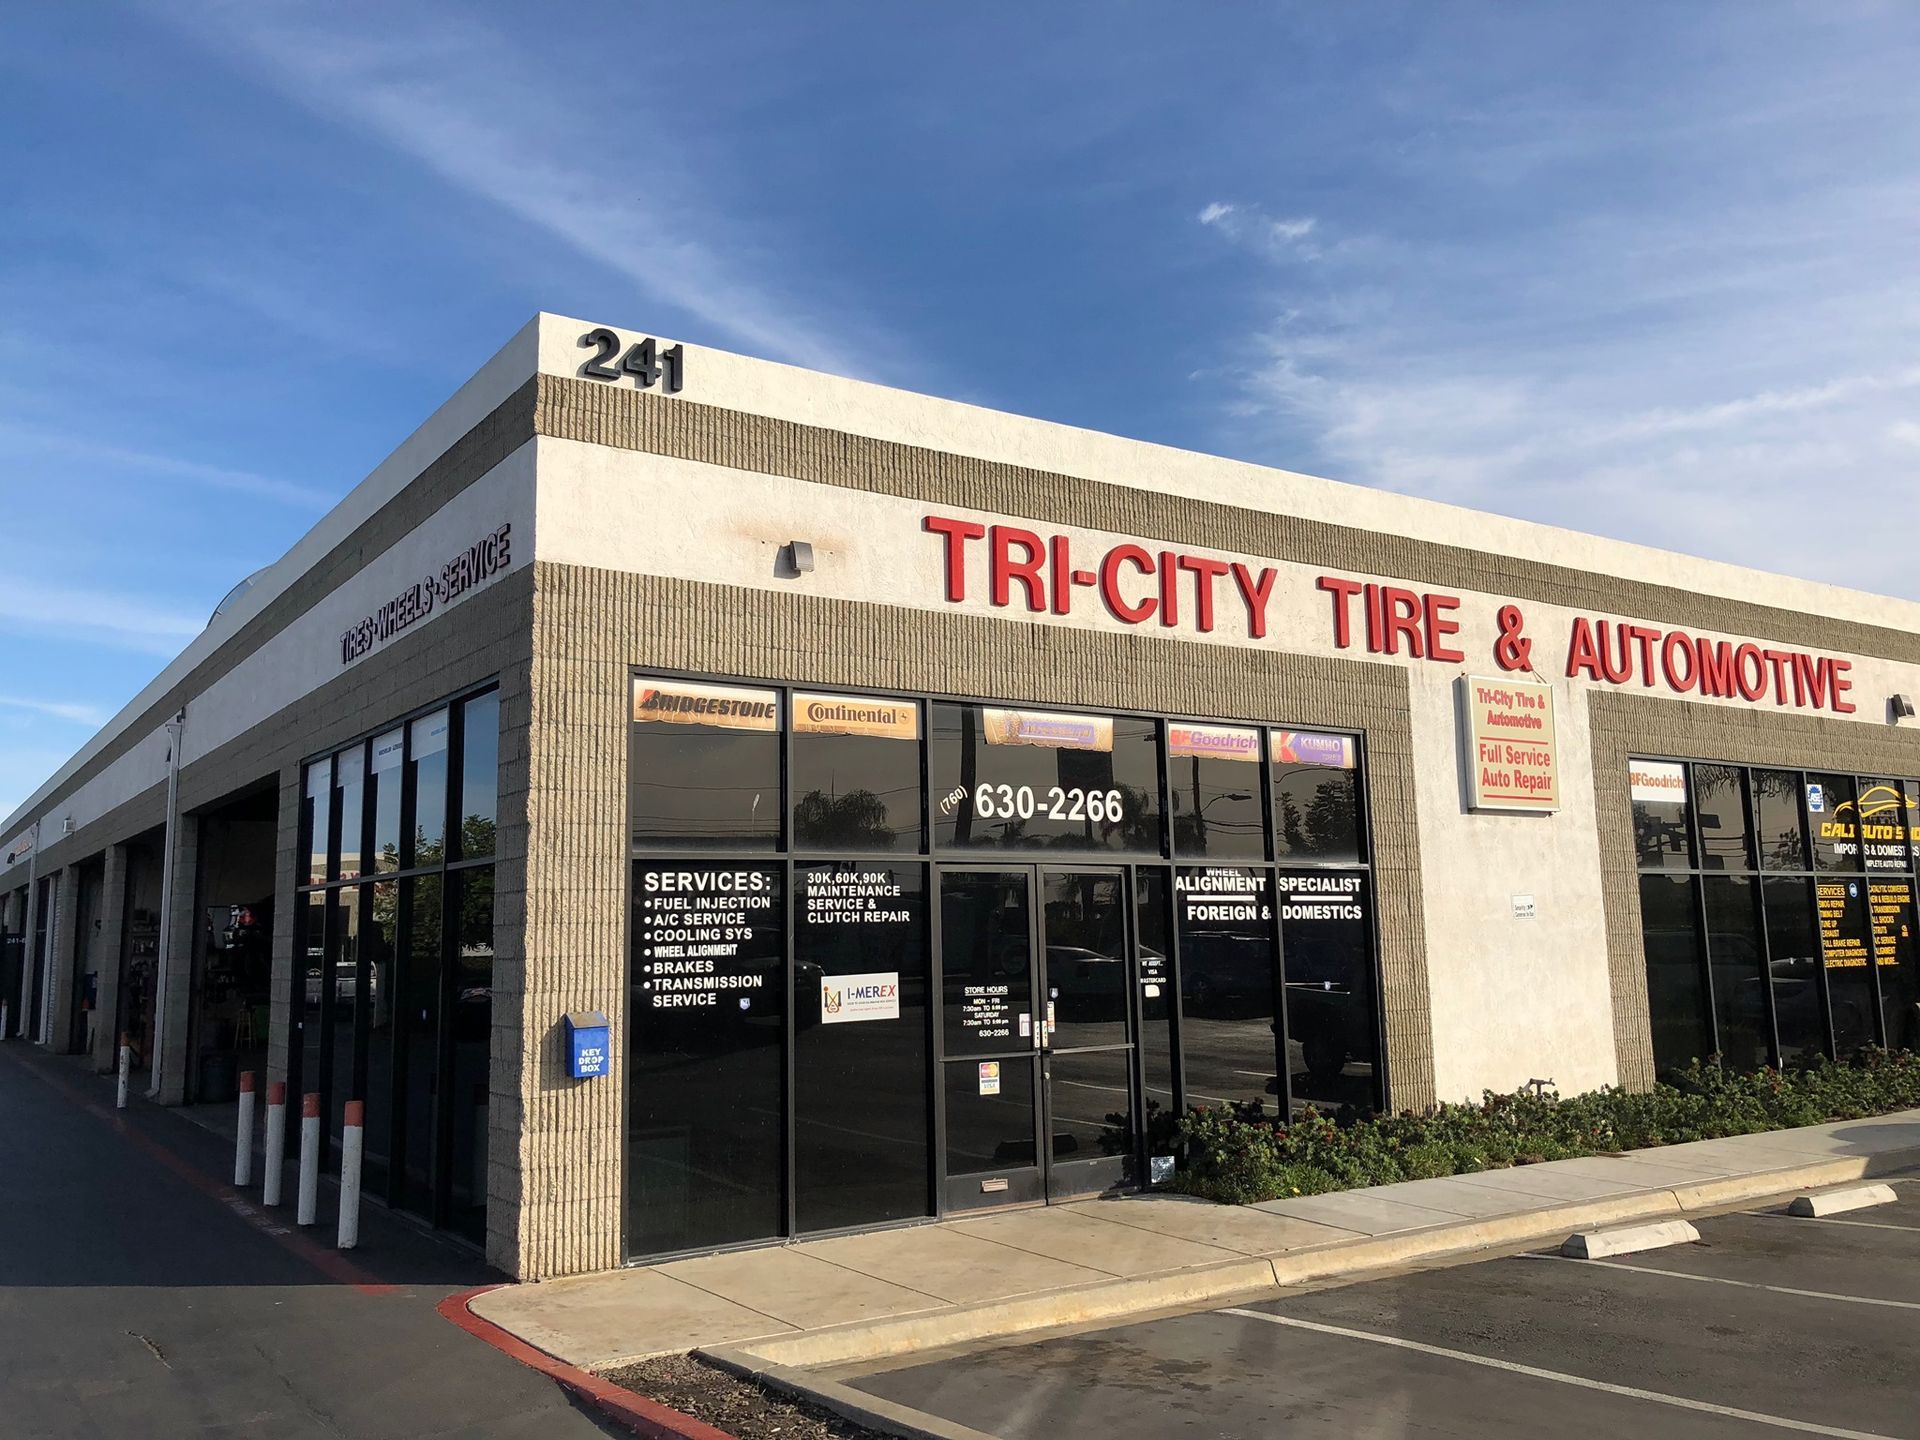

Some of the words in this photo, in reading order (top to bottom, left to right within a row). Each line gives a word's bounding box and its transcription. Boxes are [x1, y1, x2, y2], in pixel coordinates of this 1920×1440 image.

[579, 328, 684, 392] 241
[922, 516, 1278, 638] TRI-CITY
[1315, 576, 1465, 663] TIRE
[1495, 604, 1533, 671] &
[1565, 616, 1857, 713] AUTOMOTIVE
[640, 689, 776, 720] BRIDGESTONE
[1477, 687, 1513, 710] Tri-City
[1515, 692, 1535, 708] Tire
[1537, 694, 1545, 709] &
[807, 702, 897, 724] Continental
[1487, 710, 1542, 729] Automotive
[1170, 729, 1258, 749] BFGoodrich
[1300, 737, 1341, 752] KUMHO
[1480, 743, 1502, 763] Full
[1506, 745, 1551, 767] Service
[1482, 767, 1511, 788] Auto
[1513, 769, 1552, 793] Repair
[1630, 772, 1685, 789] BFGoodrich
[940, 785, 968, 815] (760)
[975, 782, 1124, 823] 630-2266
[1820, 822, 1856, 838] CALI
[1870, 844, 1877, 856] &
[807, 872, 886, 885] 30K,60K,90K
[1206, 867, 1242, 877] WHEEL
[644, 872, 771, 892] SERVICES:
[1175, 876, 1267, 892] ALIGNMENT
[1279, 877, 1361, 892] SPECIALIST
[807, 885, 901, 897] MAINTENANCE
[654, 897, 692, 910] FUEL
[697, 896, 771, 909] INJECTION
[807, 898, 864, 910] SERVICE
[868, 898, 876, 909] &
[654, 913, 679, 926] A/C
[684, 912, 745, 925] SERVICE
[808, 911, 860, 923] CLUTCH
[864, 910, 910, 922] REPAIR
[1187, 905, 1257, 920] FOREIGN
[1261, 905, 1272, 919] &
[1282, 904, 1362, 920] DOMESTICS
[653, 929, 721, 941] COOLING
[725, 927, 753, 939] SYS
[654, 946, 685, 958] WHEEL
[687, 944, 738, 957] ALIGNMENT
[653, 961, 714, 974] BRAKES
[653, 975, 763, 991] TRANSMISSION
[964, 986, 985, 994] STORE
[986, 985, 1008, 993] HOURS
[847, 984, 896, 999] I-MEREX
[653, 993, 716, 1007] SERVICE
[581, 1048, 601, 1057] KEY
[578, 1056, 604, 1065] DROP
[581, 1064, 600, 1073] BOX
